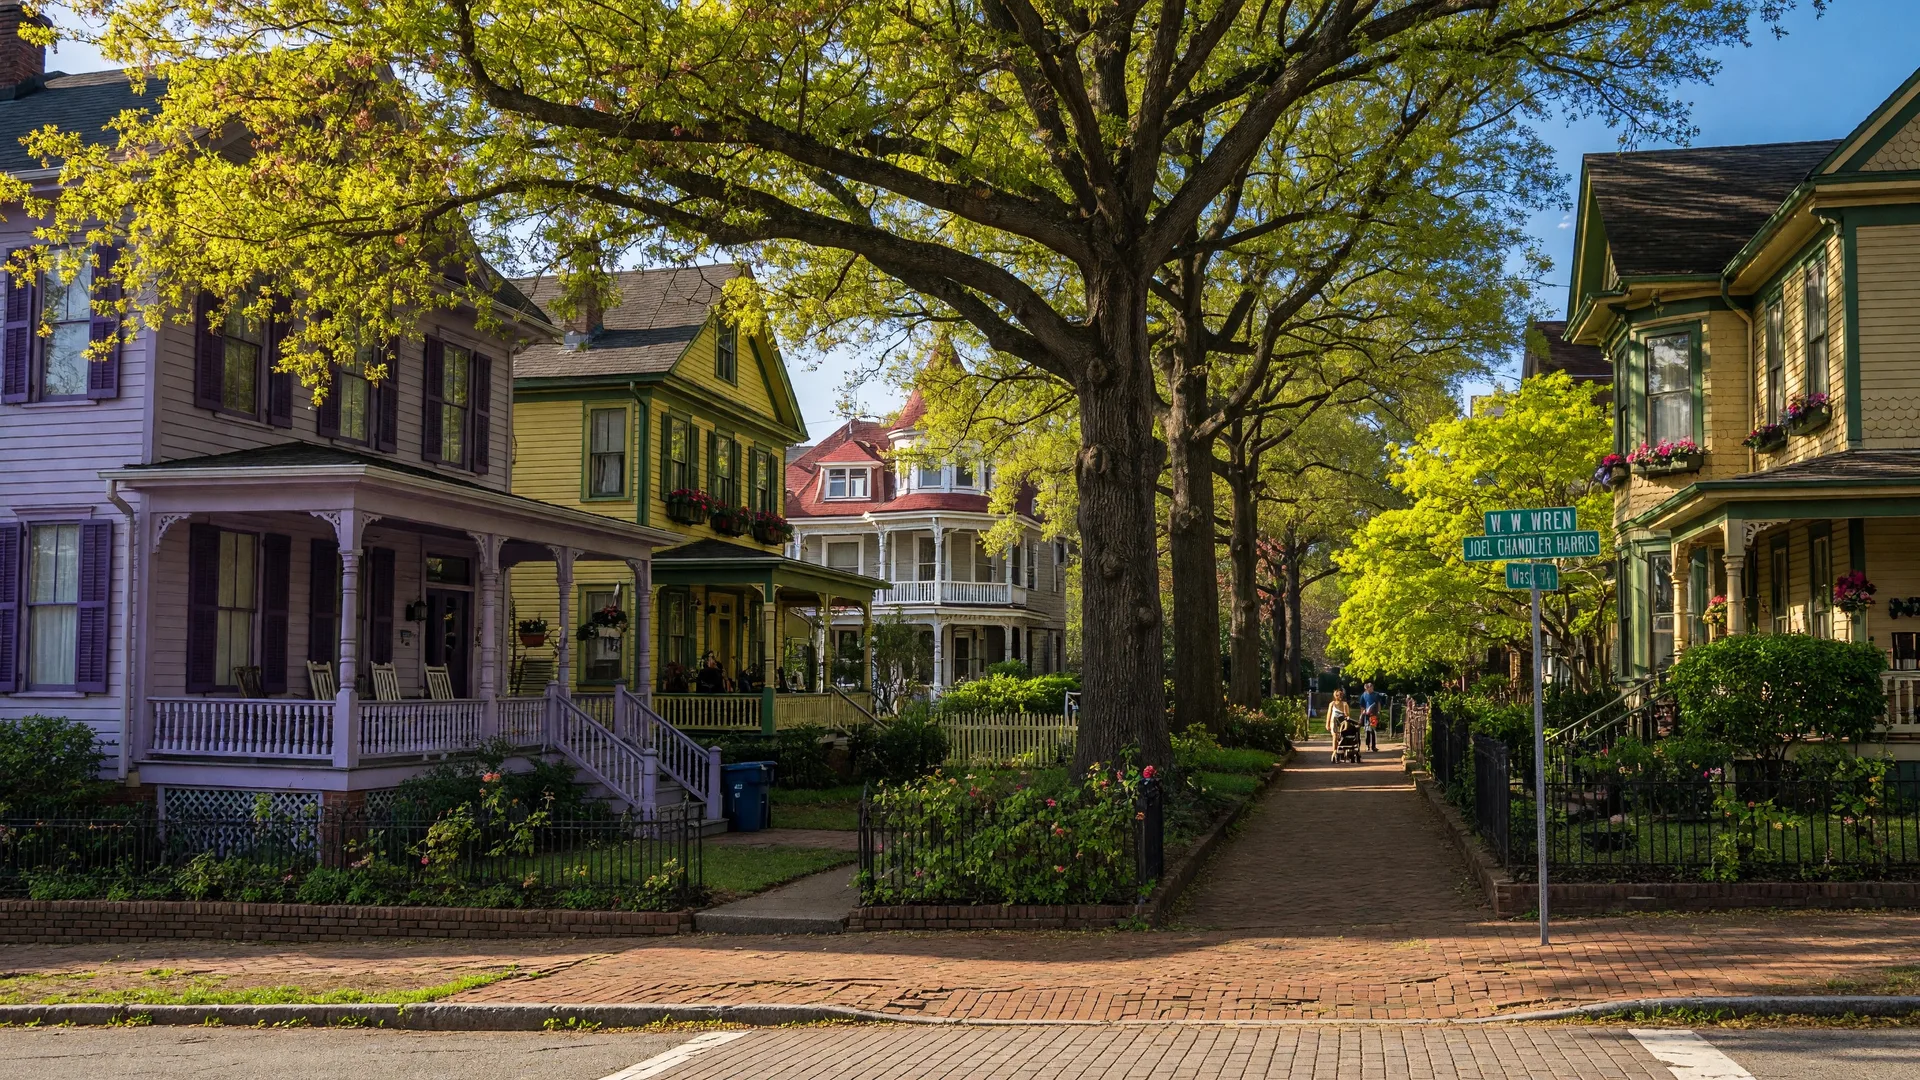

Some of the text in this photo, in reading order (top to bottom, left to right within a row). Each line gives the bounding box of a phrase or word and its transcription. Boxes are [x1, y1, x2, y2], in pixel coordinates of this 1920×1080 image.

[1490, 511, 1572, 533] W. W. WREN
[1467, 535, 1596, 558] JOEL CHANDLER HARRIS
